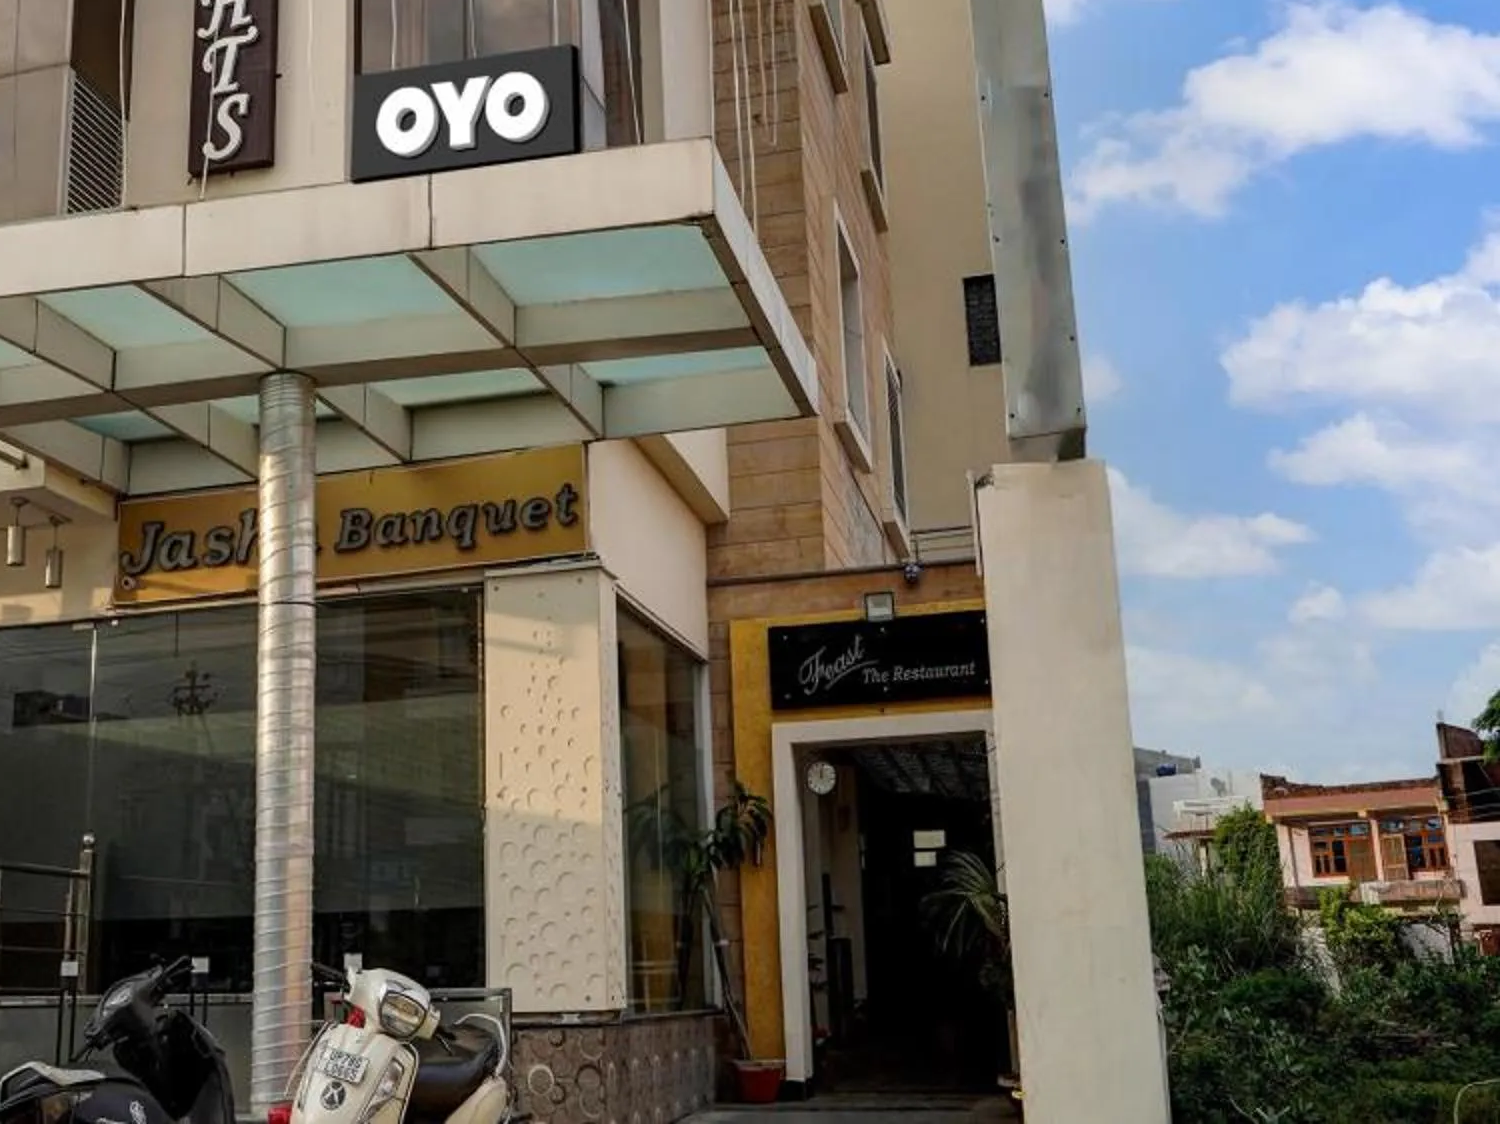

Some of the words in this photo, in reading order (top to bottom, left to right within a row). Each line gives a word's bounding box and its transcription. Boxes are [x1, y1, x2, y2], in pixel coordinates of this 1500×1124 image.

[376, 71, 550, 158] OYO
[120, 508, 322, 576] Jash
[335, 482, 579, 553] Banquet
[861, 666, 891, 685] The
[892, 660, 977, 683] Restaurant
